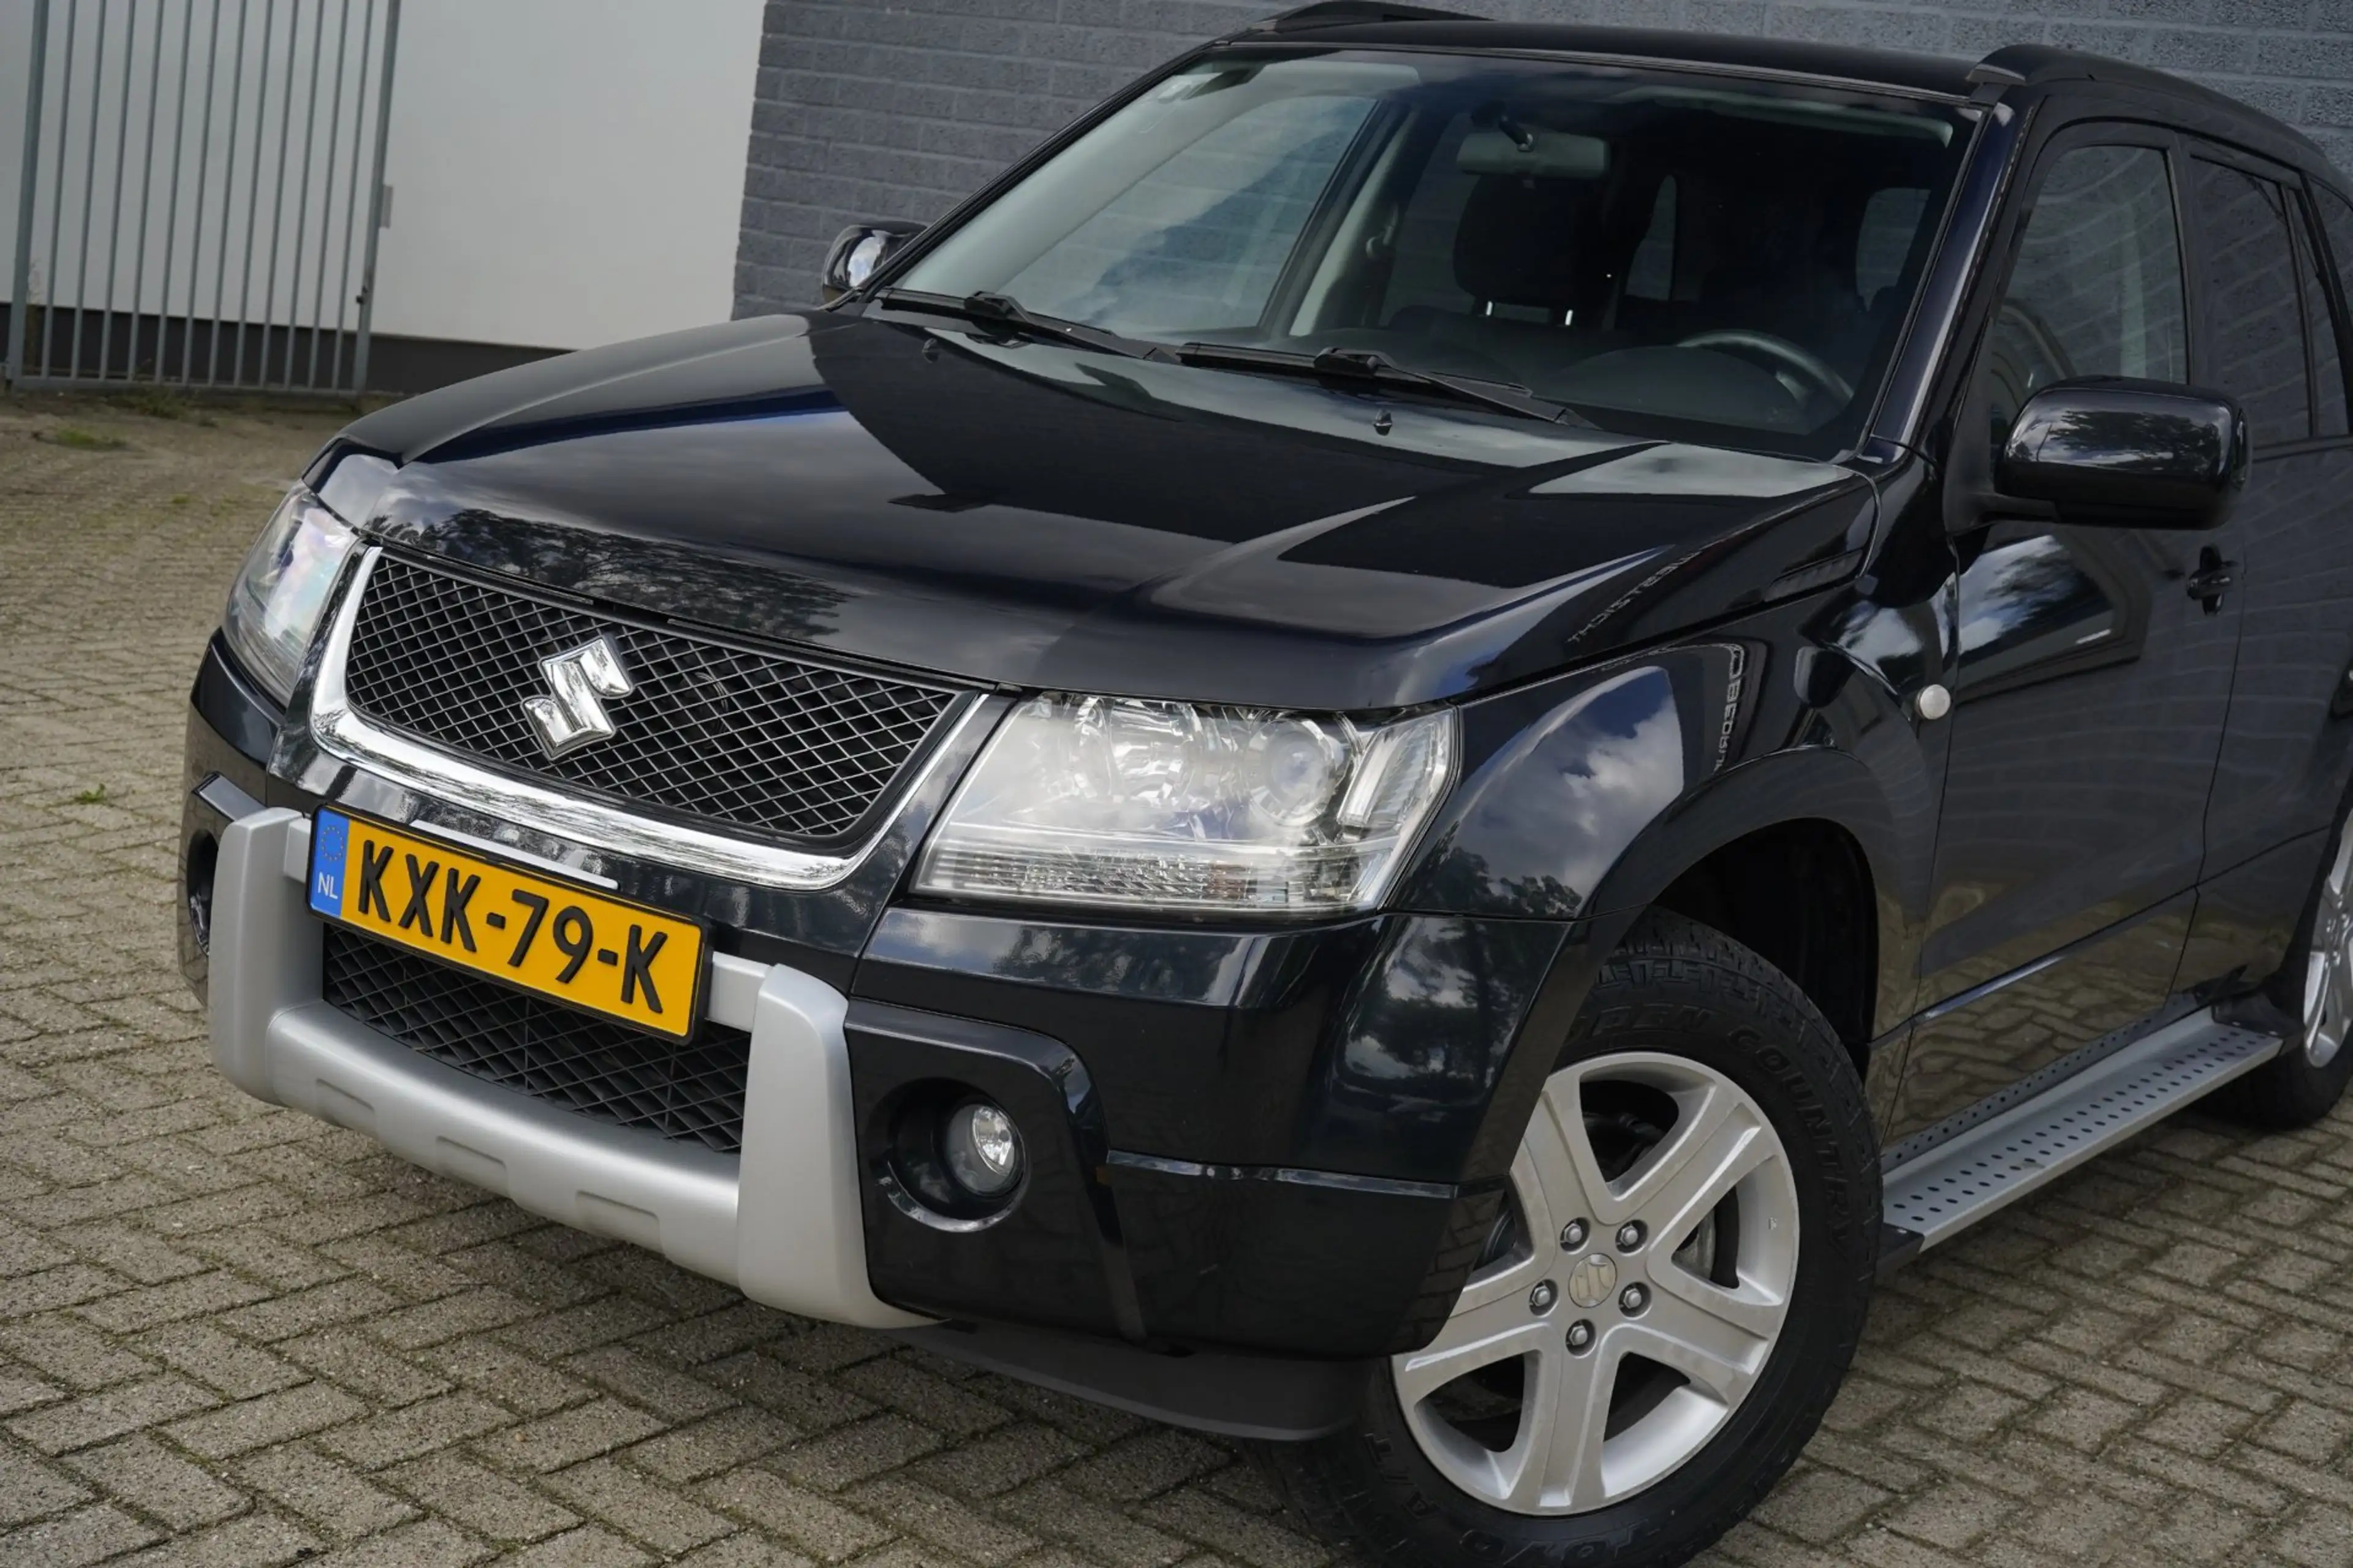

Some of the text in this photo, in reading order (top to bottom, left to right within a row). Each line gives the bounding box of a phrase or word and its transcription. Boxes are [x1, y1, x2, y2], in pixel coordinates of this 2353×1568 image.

[317, 871, 338, 900] NL
[358, 839, 669, 1014] KXK-79-K
[1728, 1025, 1854, 1261] COUNTRY
